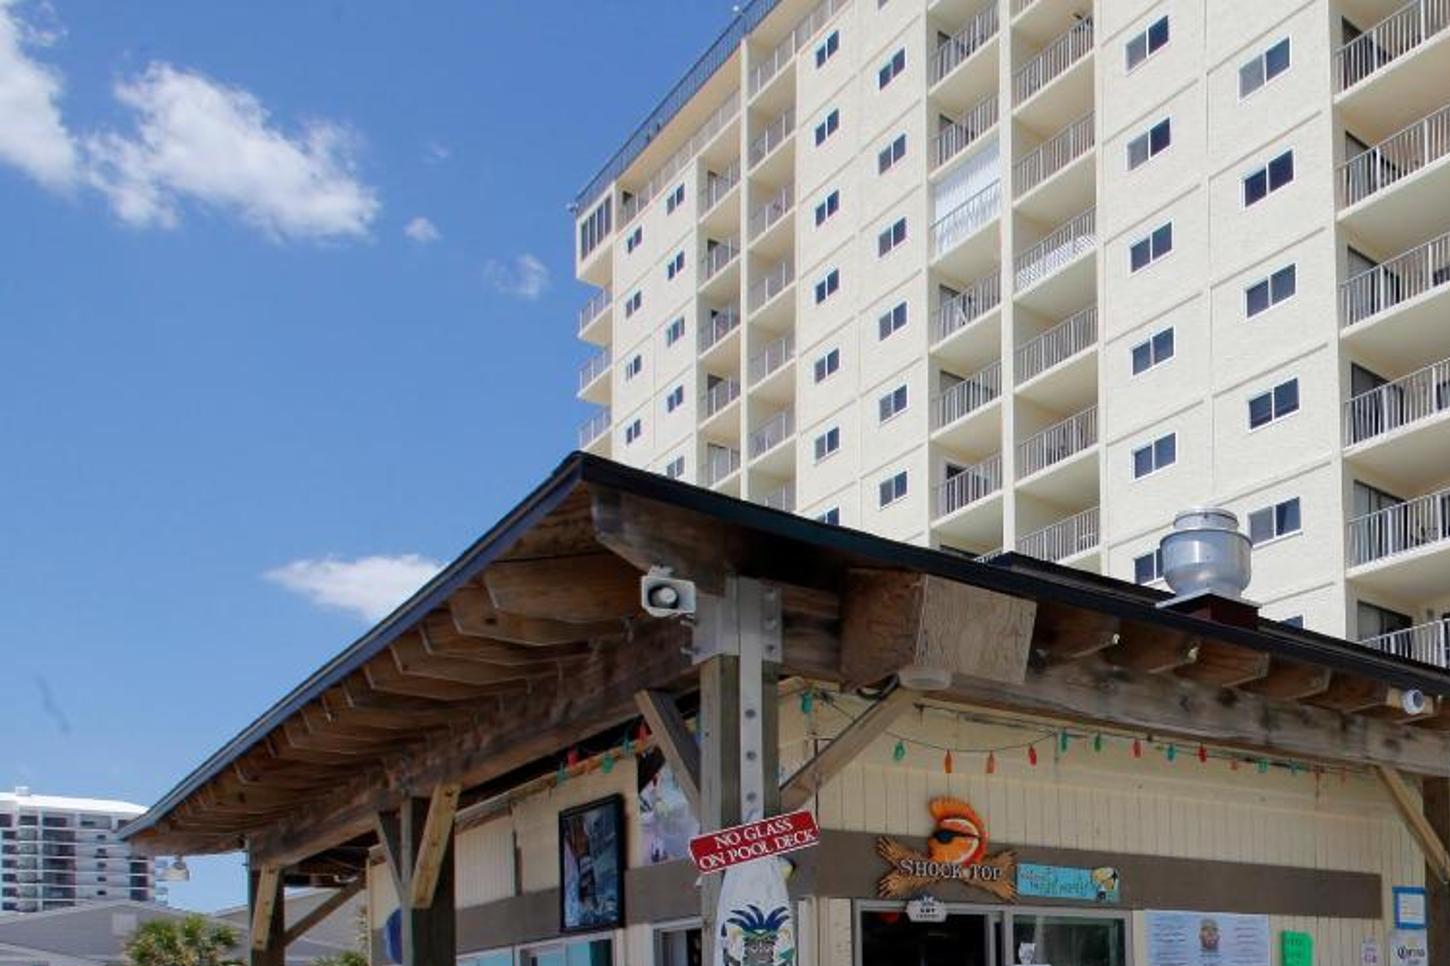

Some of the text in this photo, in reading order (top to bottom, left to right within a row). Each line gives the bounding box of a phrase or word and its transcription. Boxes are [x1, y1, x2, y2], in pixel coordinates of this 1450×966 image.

[699, 828, 817, 869] ON POOL DECK
[713, 817, 794, 849] NO GLASS
[899, 858, 1003, 881] SHOCK TOP
